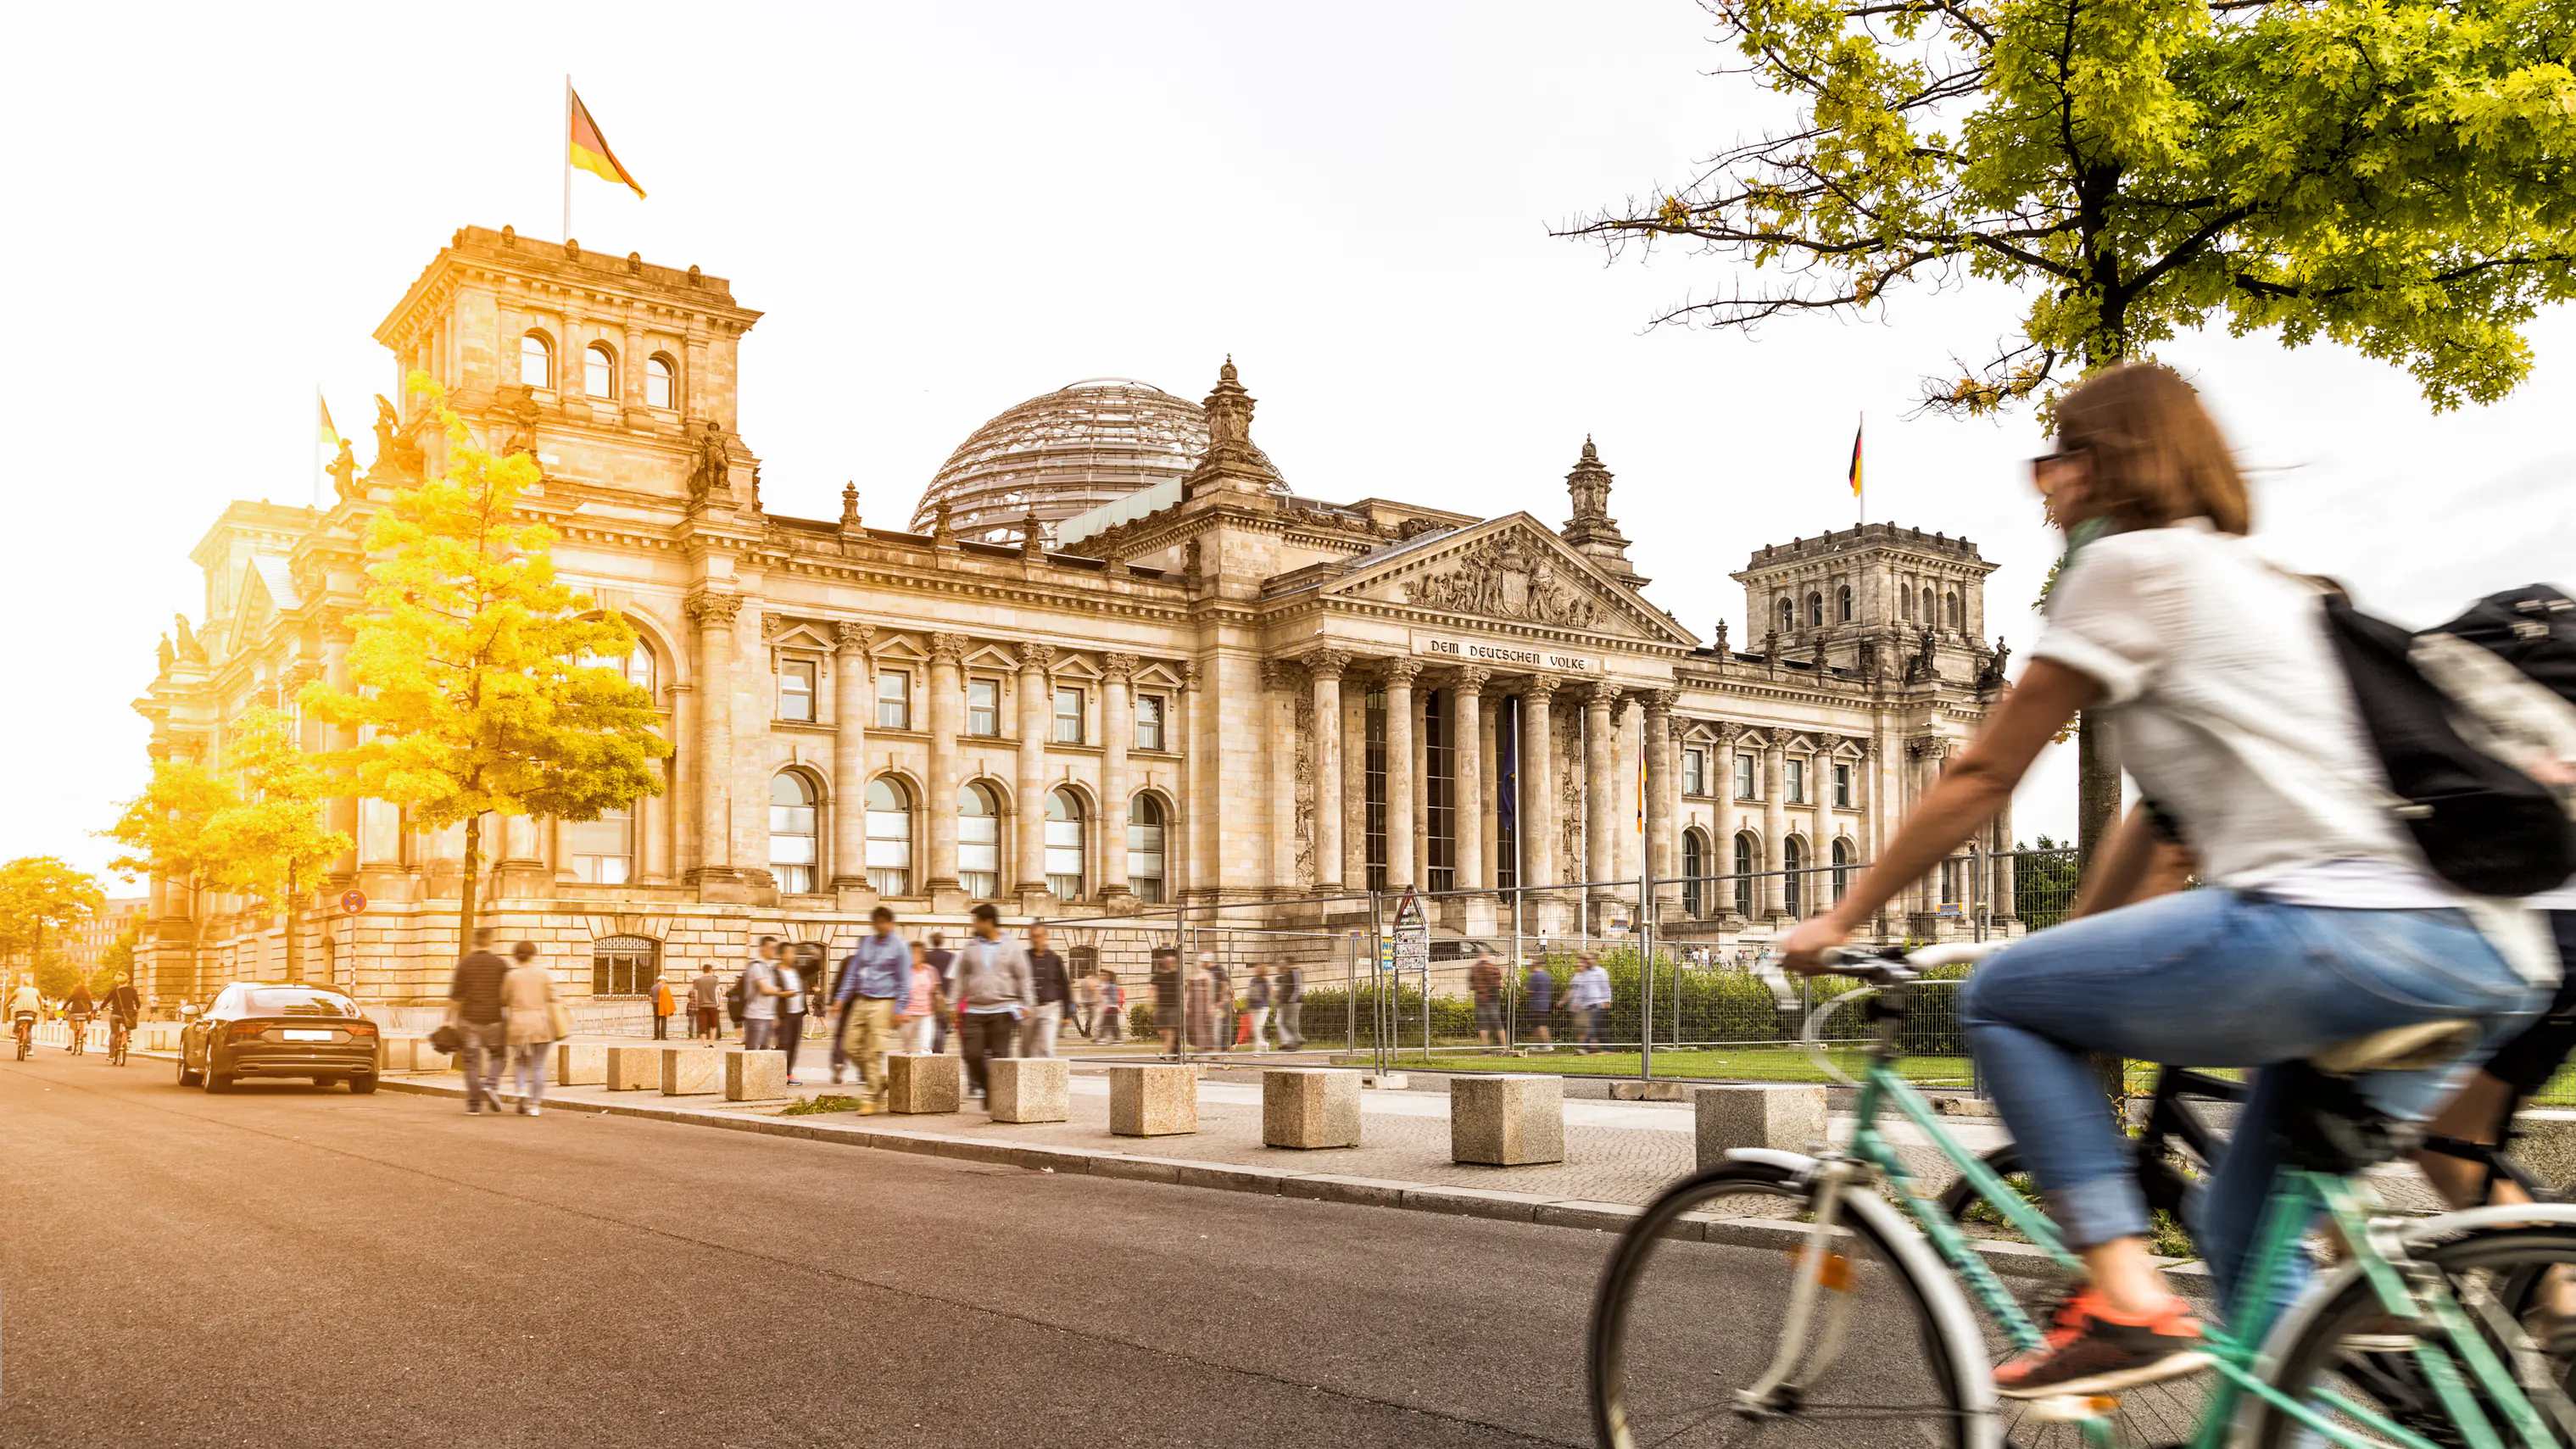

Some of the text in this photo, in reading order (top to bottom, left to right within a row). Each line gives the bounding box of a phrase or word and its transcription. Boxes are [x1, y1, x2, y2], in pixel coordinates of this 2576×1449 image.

[1430, 640, 1585, 670] DEM DEUTSCHEN VOLKE
